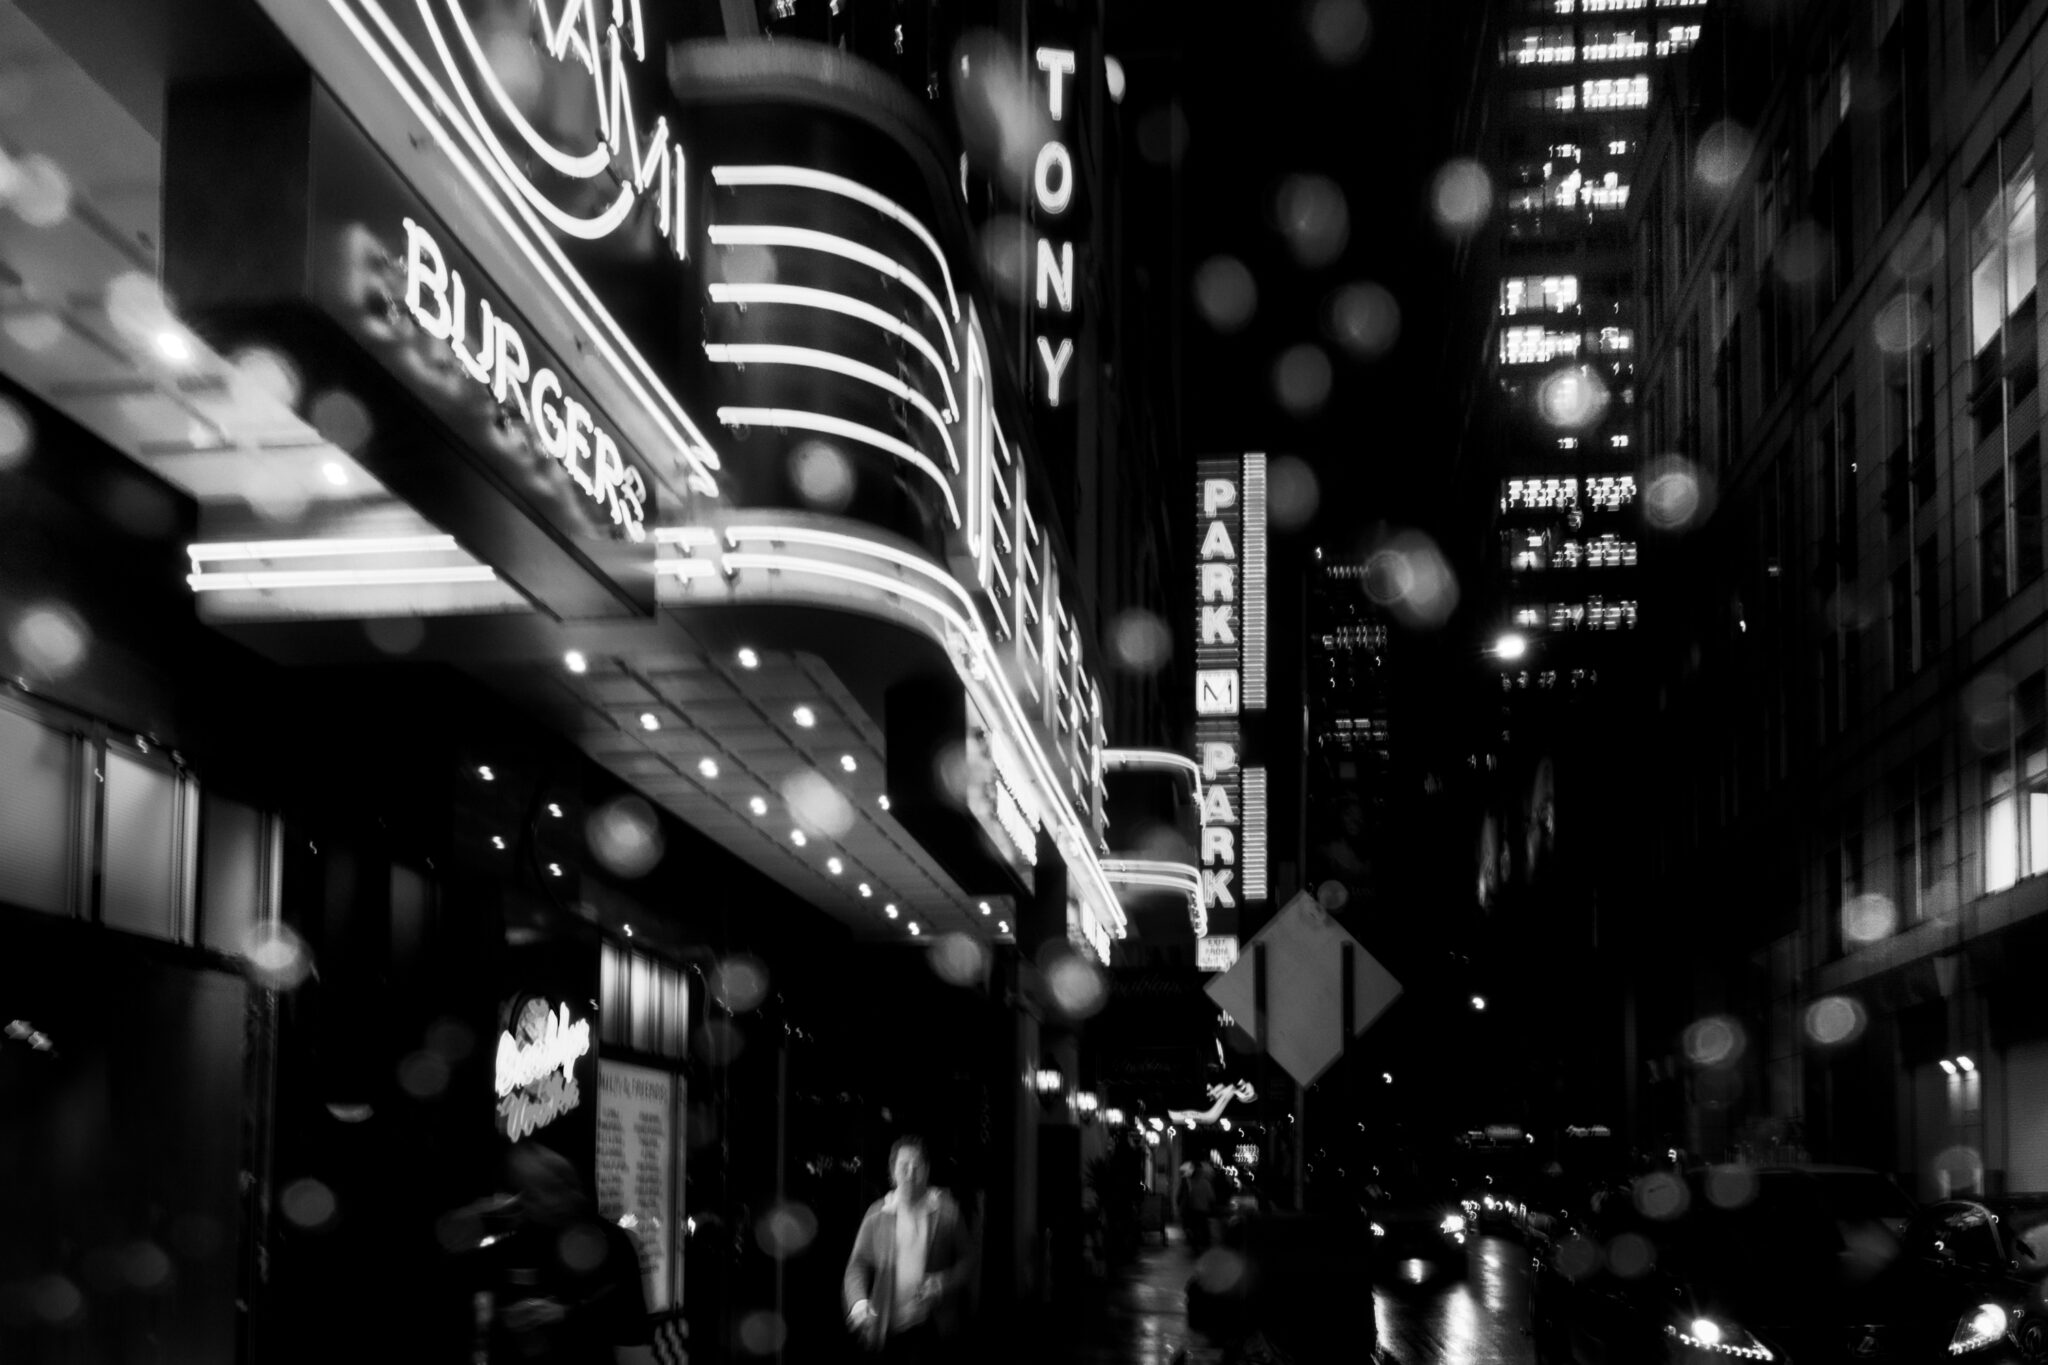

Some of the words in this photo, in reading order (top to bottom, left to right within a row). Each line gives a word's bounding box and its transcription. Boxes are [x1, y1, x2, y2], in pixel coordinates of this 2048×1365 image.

[1035, 46, 1075, 407] TONY
[402, 231, 647, 542] BURGERS
[1201, 478, 1237, 644] PARK
[1201, 741, 1237, 909] PARK
